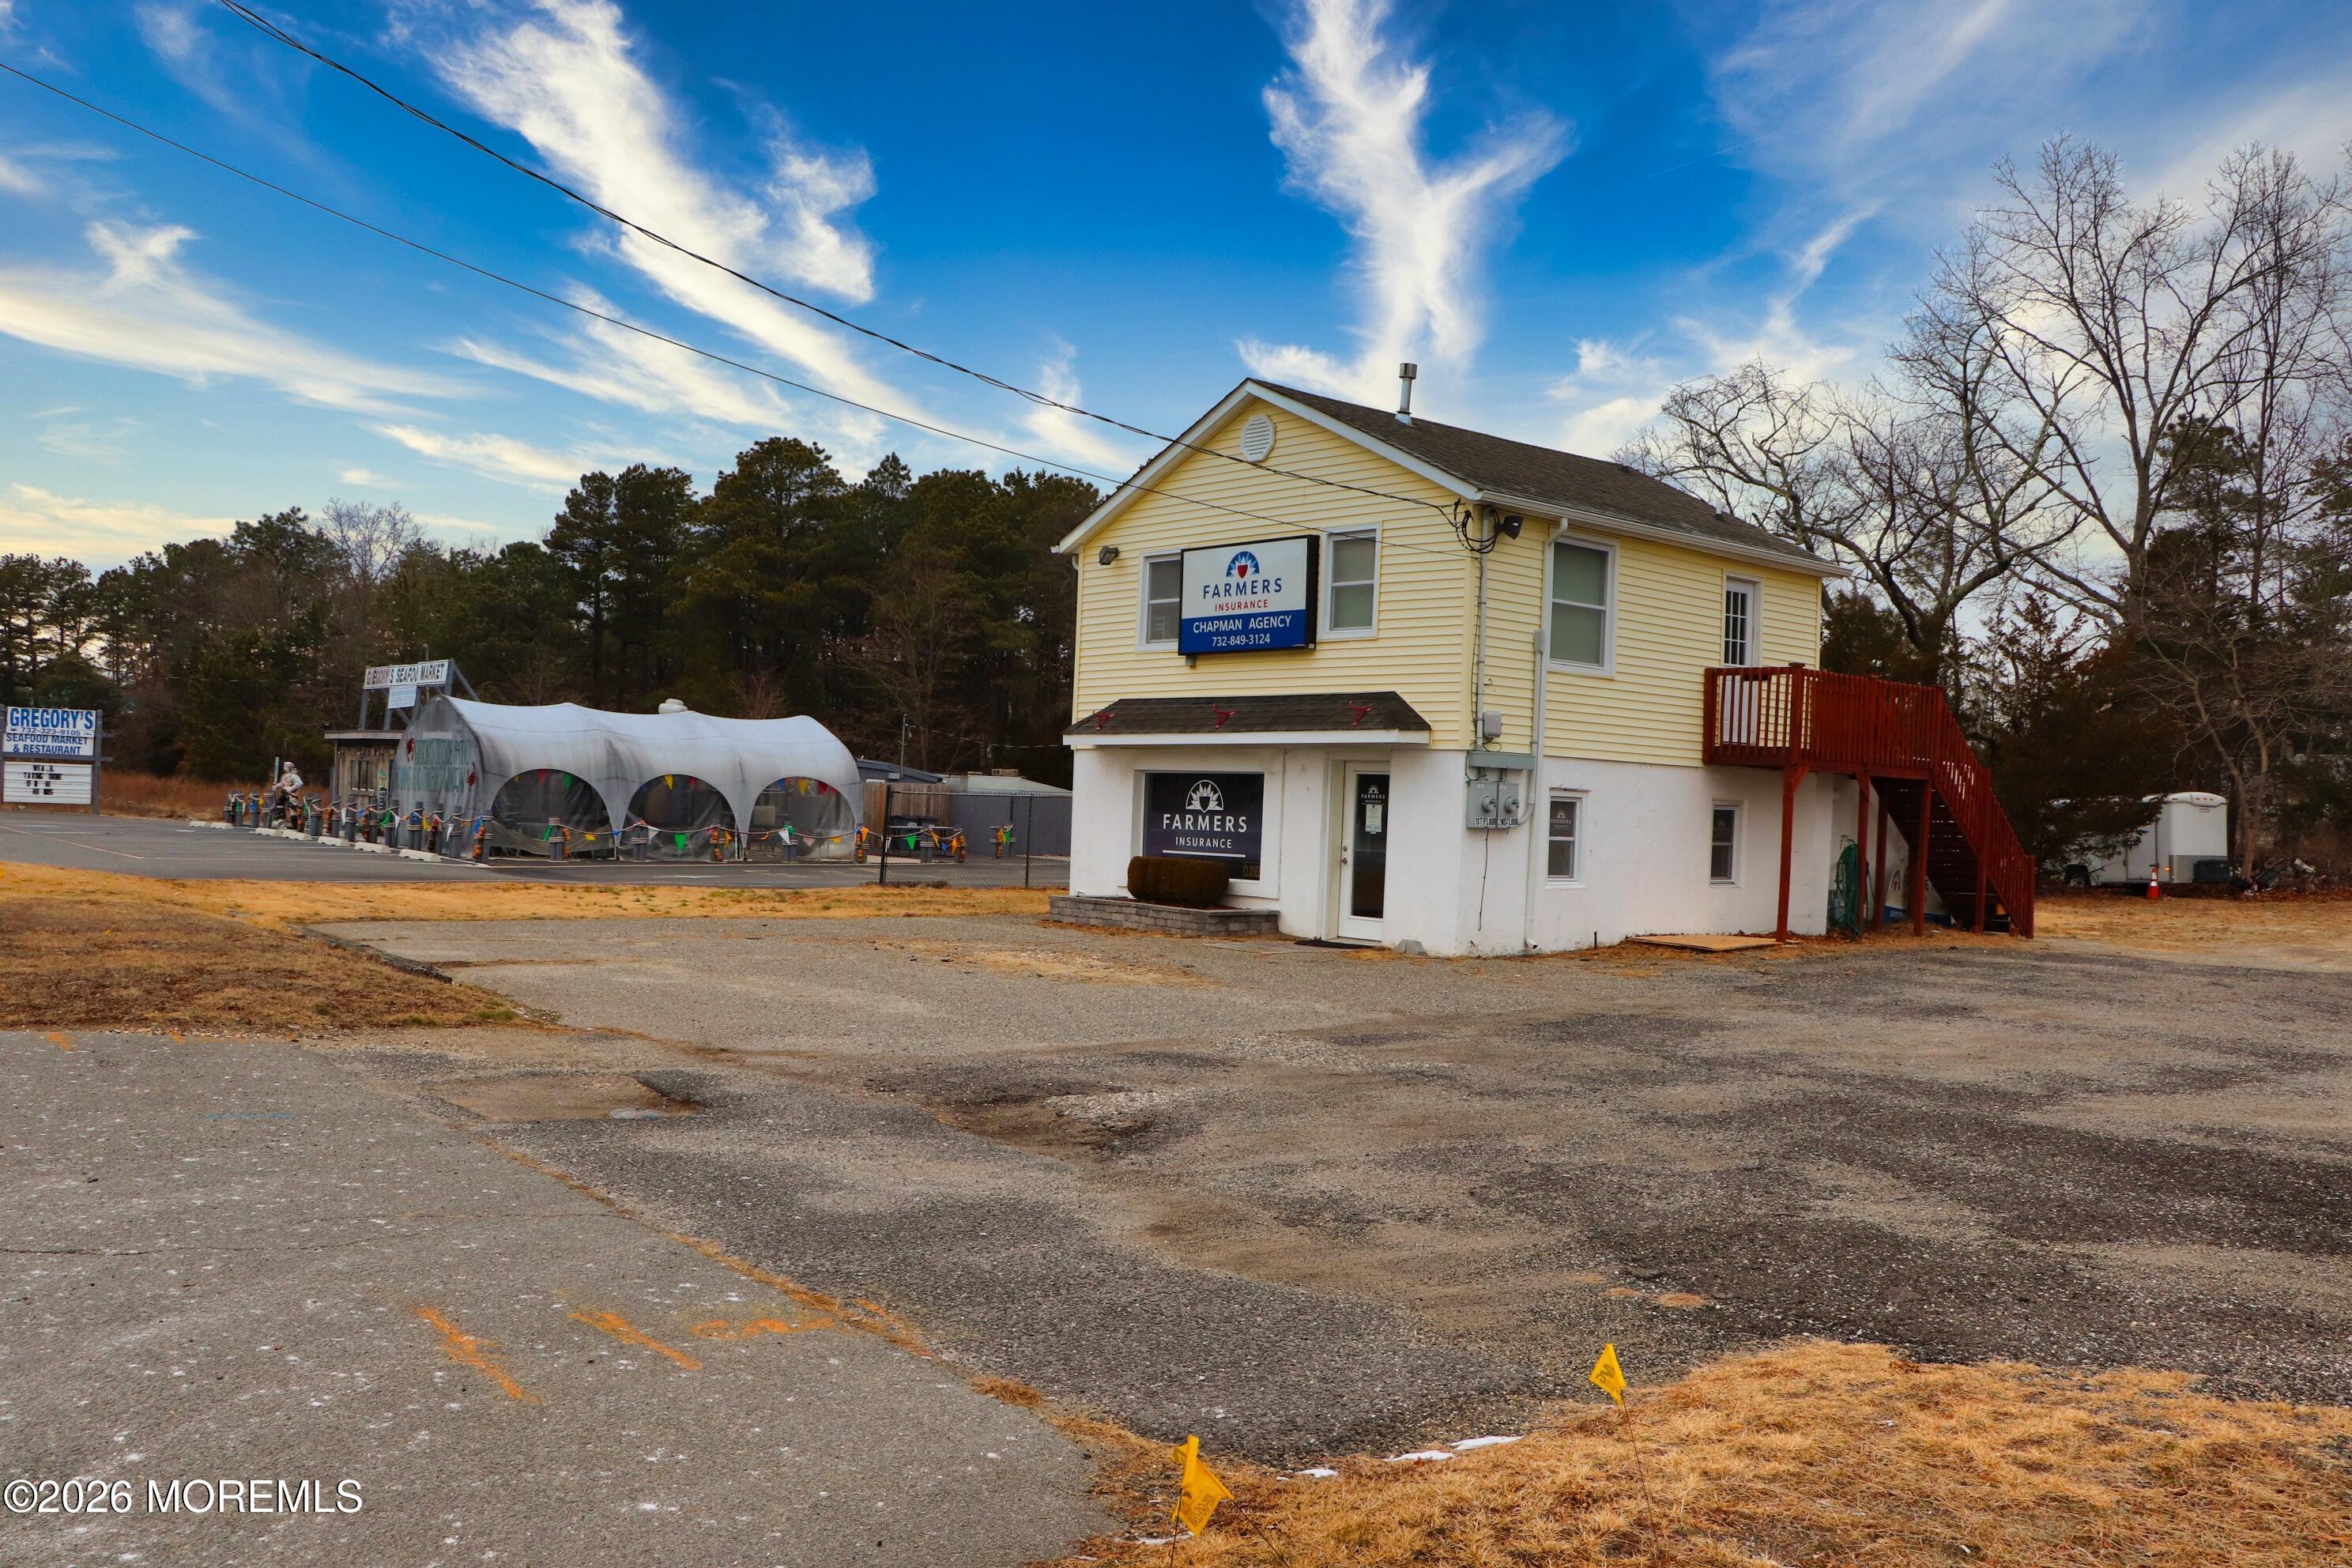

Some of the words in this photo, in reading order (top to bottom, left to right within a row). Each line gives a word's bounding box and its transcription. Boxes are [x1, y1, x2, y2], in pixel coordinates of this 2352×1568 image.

[1203, 578, 1283, 599] FARMERS
[1215, 599, 1268, 612] INSURANCE
[1193, 619, 1242, 633] CHAPMAN
[1249, 615, 1292, 630] AGENCY
[1212, 633, 1271, 647] 732-849-3124
[420, 663, 444, 680] MARKET
[9, 707, 94, 729] GREGORY'S
[6, 733, 48, 743] SEAFOOD
[51, 736, 89, 745] MARKET
[21, 727, 81, 737] 732-323-9105
[13, 744, 21, 753] &
[23, 744, 81, 755] RESTAURANT
[1163, 813, 1247, 833] FARMERS
[1175, 836, 1232, 848] INSURANCE
